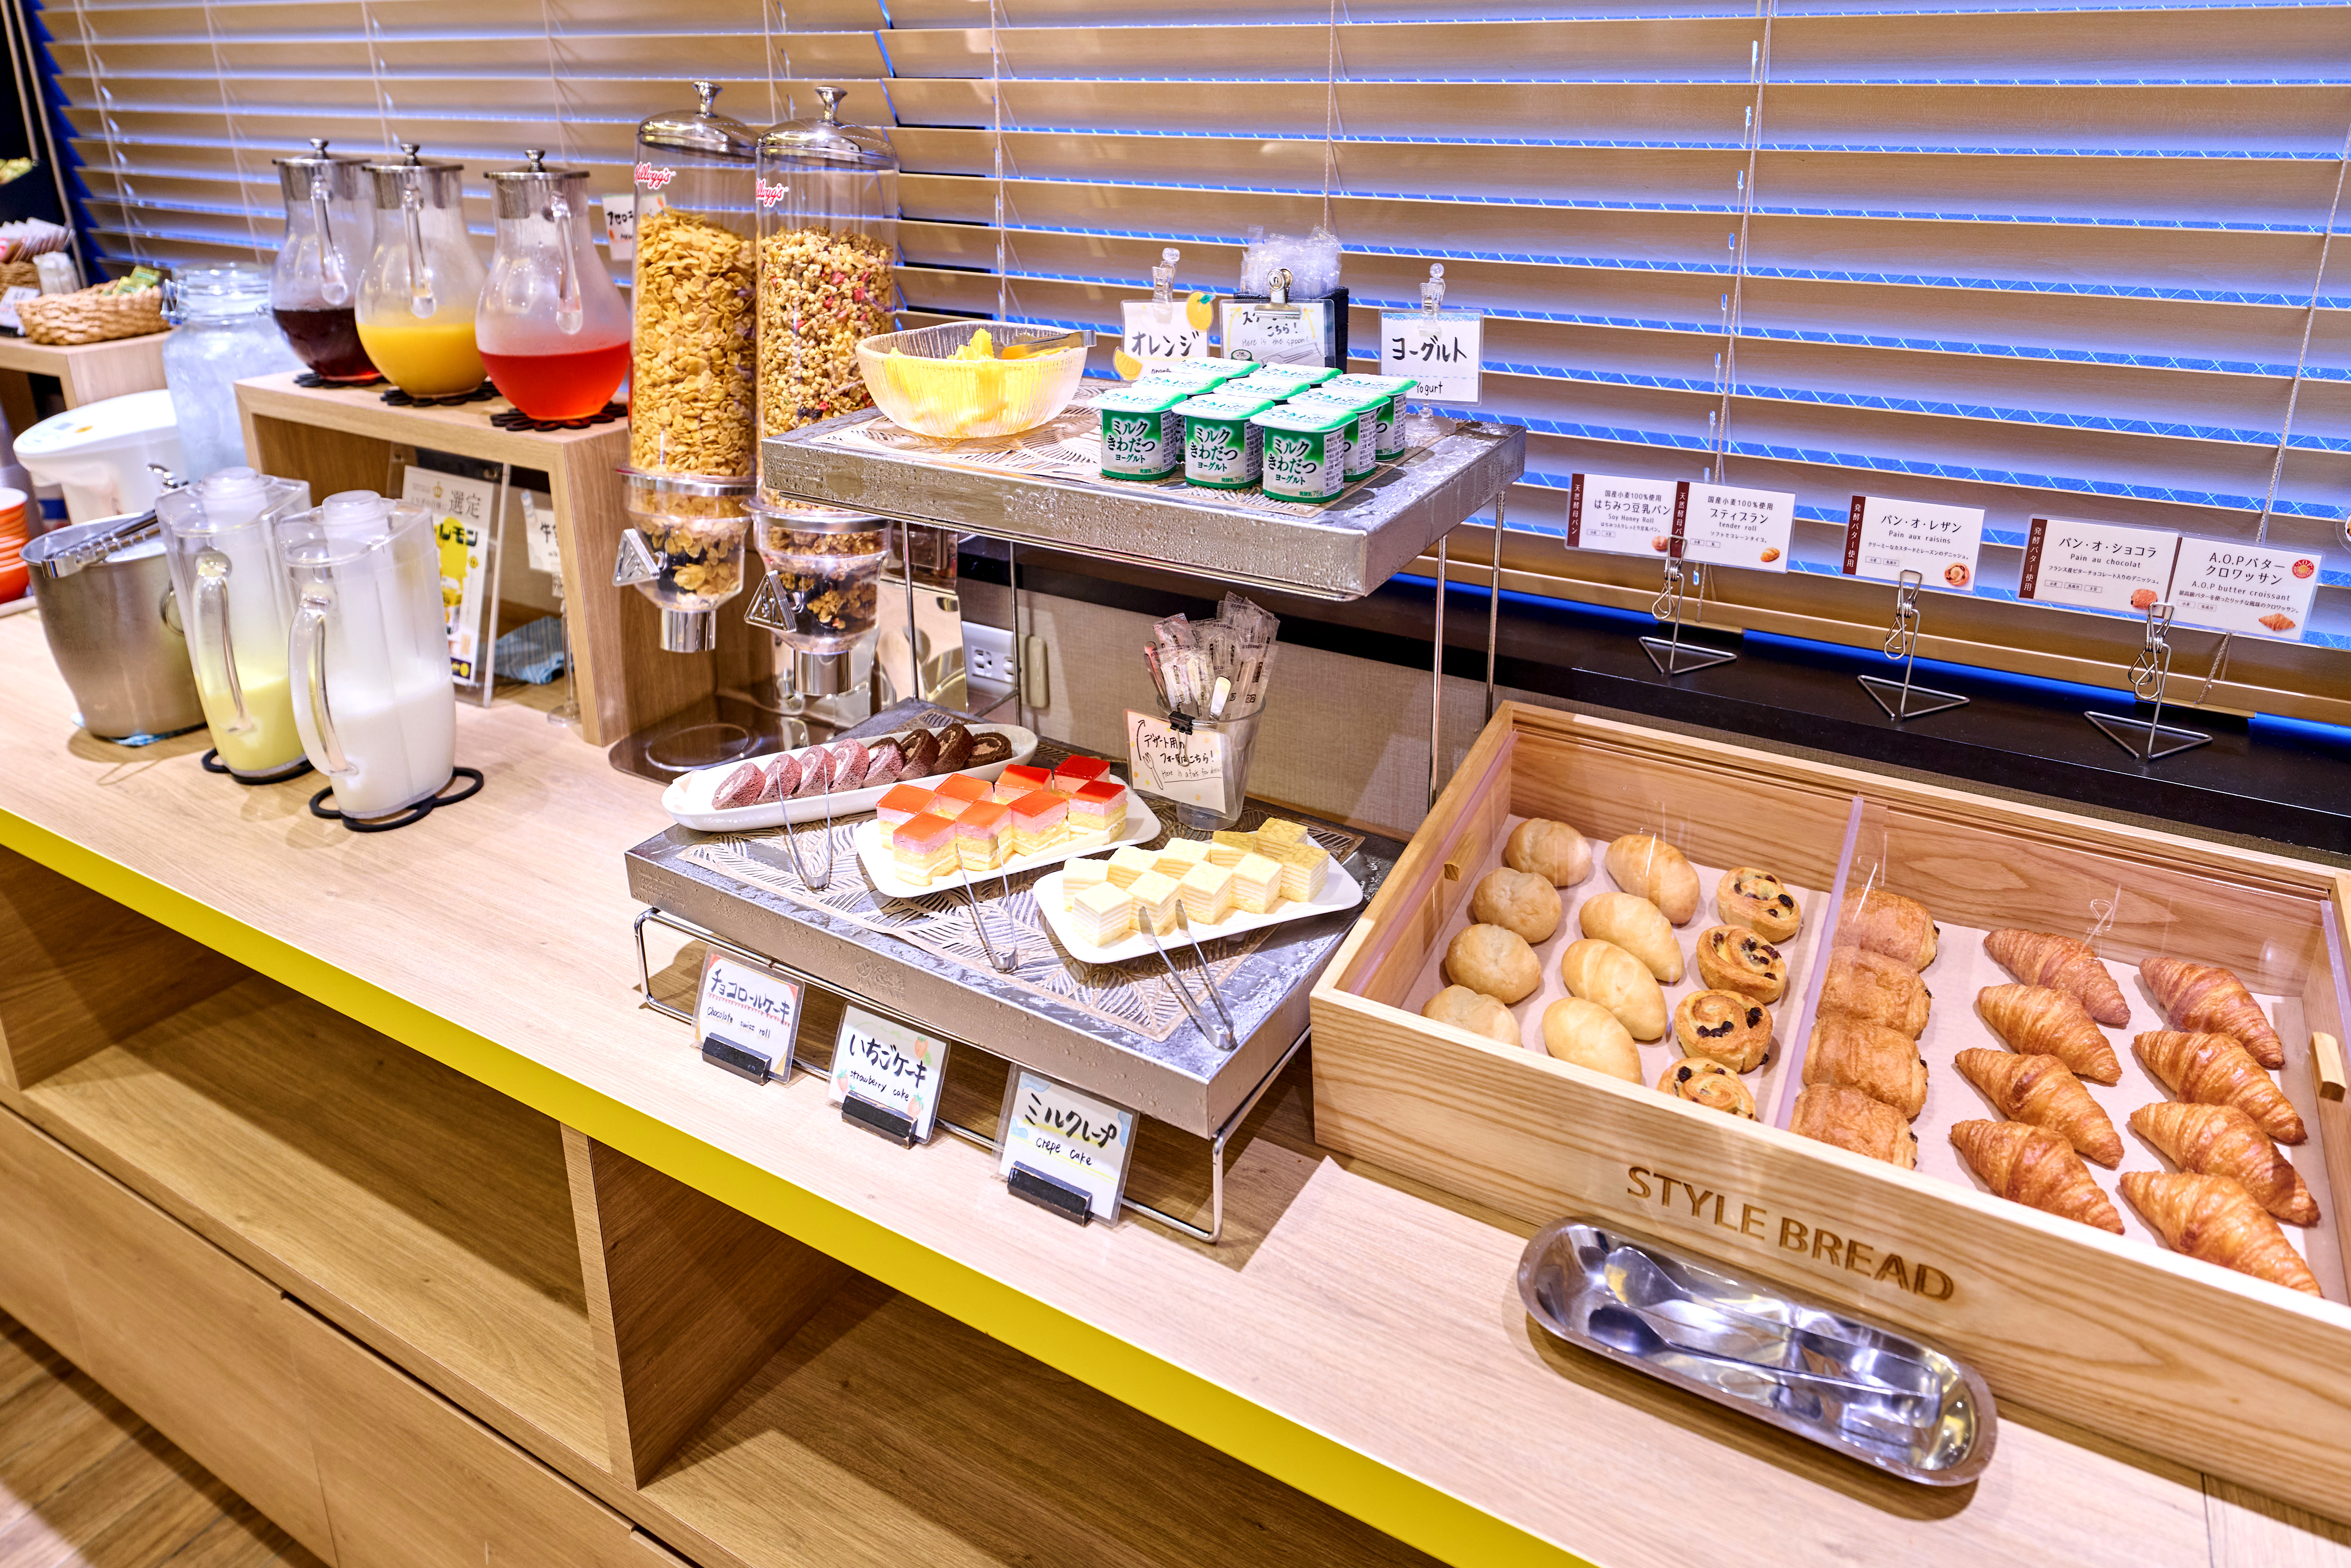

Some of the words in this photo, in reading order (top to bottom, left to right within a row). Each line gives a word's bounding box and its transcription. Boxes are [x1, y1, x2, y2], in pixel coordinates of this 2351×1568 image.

[1131, 330, 1199, 357] オレンジ
[1242, 338, 1257, 347] Here
[1261, 337, 1267, 346] is
[1272, 338, 1283, 346] the
[1392, 335, 1467, 363] ヨーグルト
[1416, 381, 1444, 396] Yogurt
[1113, 420, 1148, 437] ミルク
[1196, 427, 1231, 445] ミルク
[1107, 434, 1156, 453] きわだつ
[1190, 441, 1238, 462] きわだつ
[1275, 438, 1310, 457] ミルク
[1115, 453, 1146, 464] ヨーグルト
[1197, 461, 1227, 472] ヨーグルト
[1268, 453, 1317, 474] きわだつ
[1275, 474, 1306, 485] ヨーグルト
[1605, 490, 1662, 502] 国産小麦100%使用
[1708, 496, 1774, 510] 国産小麦100%使用
[1572, 484, 1581, 534] 天然酵母パン
[1594, 499, 1671, 515] はちみつ豆乳パン
[1608, 513, 1619, 521] Soy
[1621, 515, 1639, 523] Honey
[1719, 521, 1741, 530] tender
[1881, 514, 1962, 533] パン・オ・レザン
[434, 521, 478, 547] レモン
[1846, 503, 1862, 568] 発酵バター使用
[1888, 530, 1904, 538] Pain
[1925, 535, 1951, 544] raisins
[2059, 537, 2157, 558] パン・オ・ショコラ
[2024, 527, 2042, 591] 発酵バター使用
[2070, 553, 2087, 562] Pain
[2106, 558, 2141, 568] chocolat
[2205, 565, 2283, 585] クロワッサン
[2192, 580, 2215, 590] A.O.P
[2218, 584, 2246, 595] butter
[2249, 587, 2291, 601] croissant
[1161, 770, 1174, 780] Here
[1177, 769, 1182, 777] is
[710, 968, 790, 1026] チョコロールケーキ
[739, 1021, 755, 1031] swiss
[759, 1028, 771, 1039] roll
[849, 1034, 928, 1089] いちごケーキ
[850, 1070, 887, 1092] strawberry
[893, 1088, 909, 1102] cake
[1025, 1093, 1117, 1148] ミルクレープ
[1626, 1166, 1768, 1241] STYLE
[1778, 1216, 1955, 1302] BREAD
